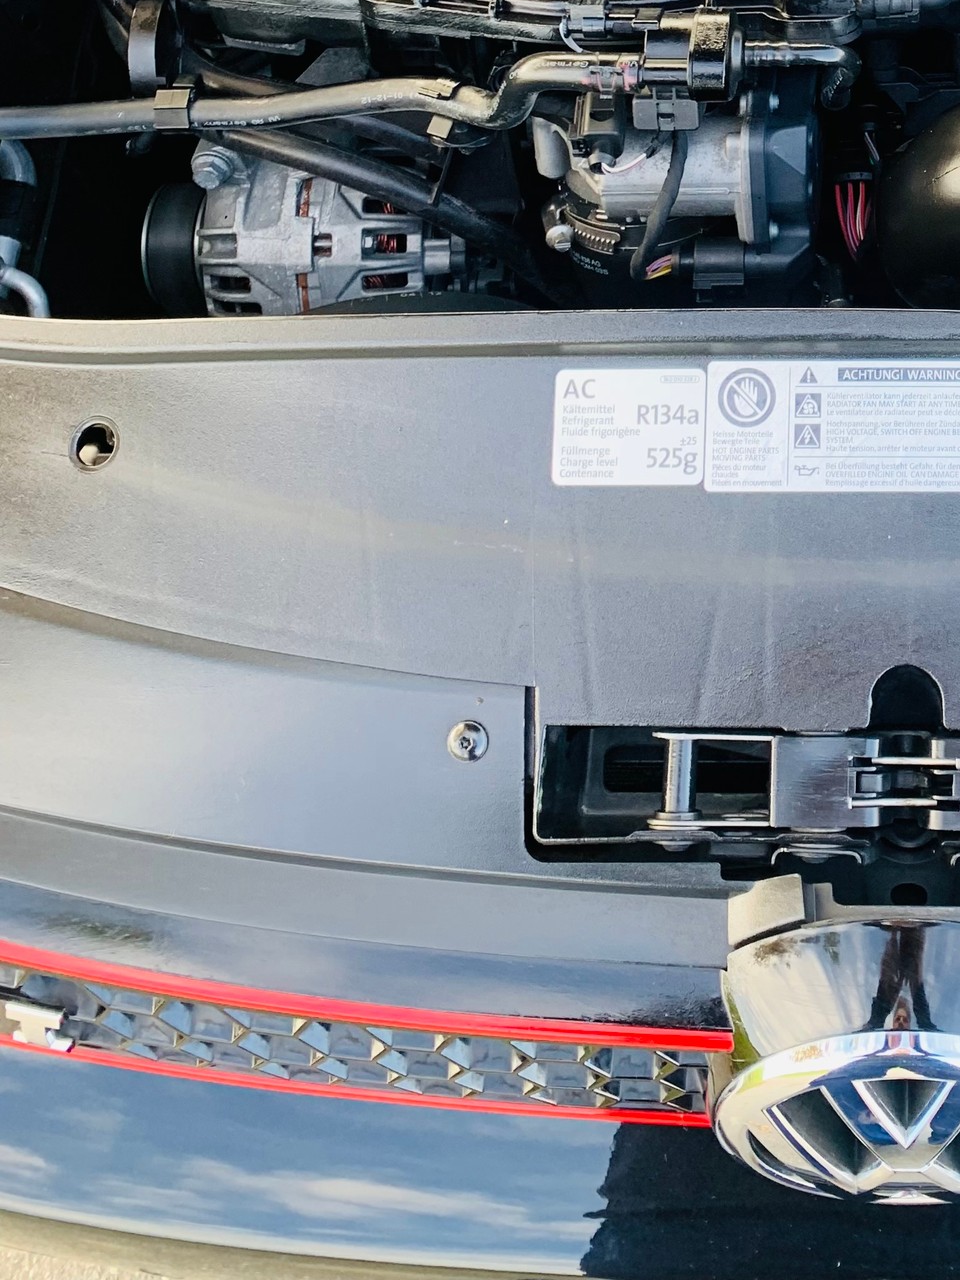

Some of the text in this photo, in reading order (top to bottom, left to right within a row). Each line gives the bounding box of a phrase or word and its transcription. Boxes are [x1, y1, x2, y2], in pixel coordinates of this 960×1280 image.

[843, 369, 903, 380] ACHTUNG!
[562, 378, 596, 400] AC
[562, 404, 616, 414] Kältemittel
[826, 400, 860, 408] RADIATOR
[863, 400, 877, 408] FAN
[878, 400, 894, 408] MAY
[896, 400, 916, 408] START
[918, 400, 926, 408] AT
[928, 400, 942, 408] ANY
[636, 404, 700, 425] R134a
[562, 416, 614, 427] Refrigerant
[561, 427, 641, 438] Fluide frigorigène
[826, 428, 845, 436] HIGH
[880, 428, 908, 436] SWITCH
[908, 428, 923, 436] OFF
[924, 428, 950, 436] ENGINE
[680, 437, 697, 446] ±25
[560, 446, 610, 457] Füllmenge
[560, 458, 618, 468] Charge level
[646, 448, 698, 475] 525g
[559, 469, 614, 478] Contenance
